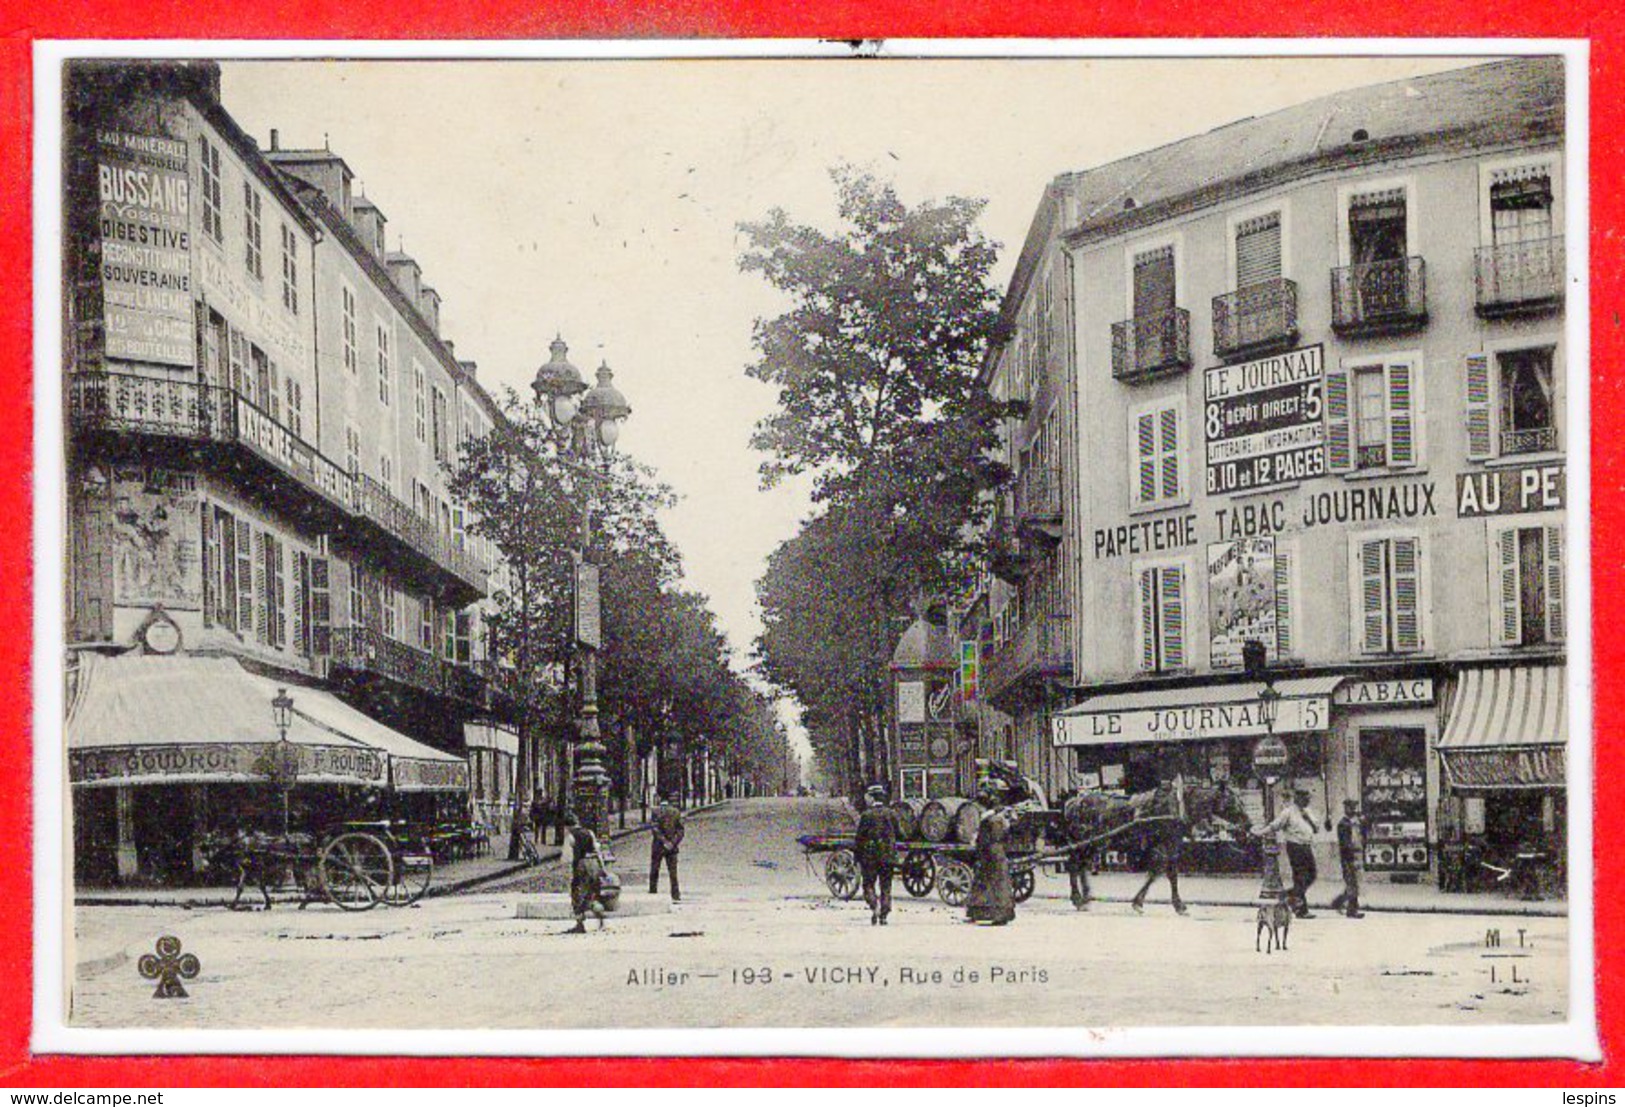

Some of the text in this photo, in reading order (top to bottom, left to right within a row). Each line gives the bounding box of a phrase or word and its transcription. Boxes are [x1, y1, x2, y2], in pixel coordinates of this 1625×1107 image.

[99, 164, 188, 214] BUSSANG
[102, 219, 188, 251] DIGESTIVE
[104, 264, 188, 291] SOUVERAINE
[1208, 350, 1320, 399] LE JOURNAL
[1262, 396, 1300, 419] DIRECT
[1305, 382, 1321, 420] 5
[1206, 403, 1220, 439] 8
[1254, 458, 1271, 484] 12
[1274, 447, 1324, 481] PAGES
[1460, 465, 1567, 514] AU PE
[1095, 481, 1436, 559] PAPETERIE TABAC JOURNAUX
[1345, 681, 1425, 703] TABAC
[1056, 718, 1067, 744] 8
[1092, 714, 1122, 736] LE
[1147, 703, 1269, 732] JOURNAL
[1305, 700, 1319, 729] 5
